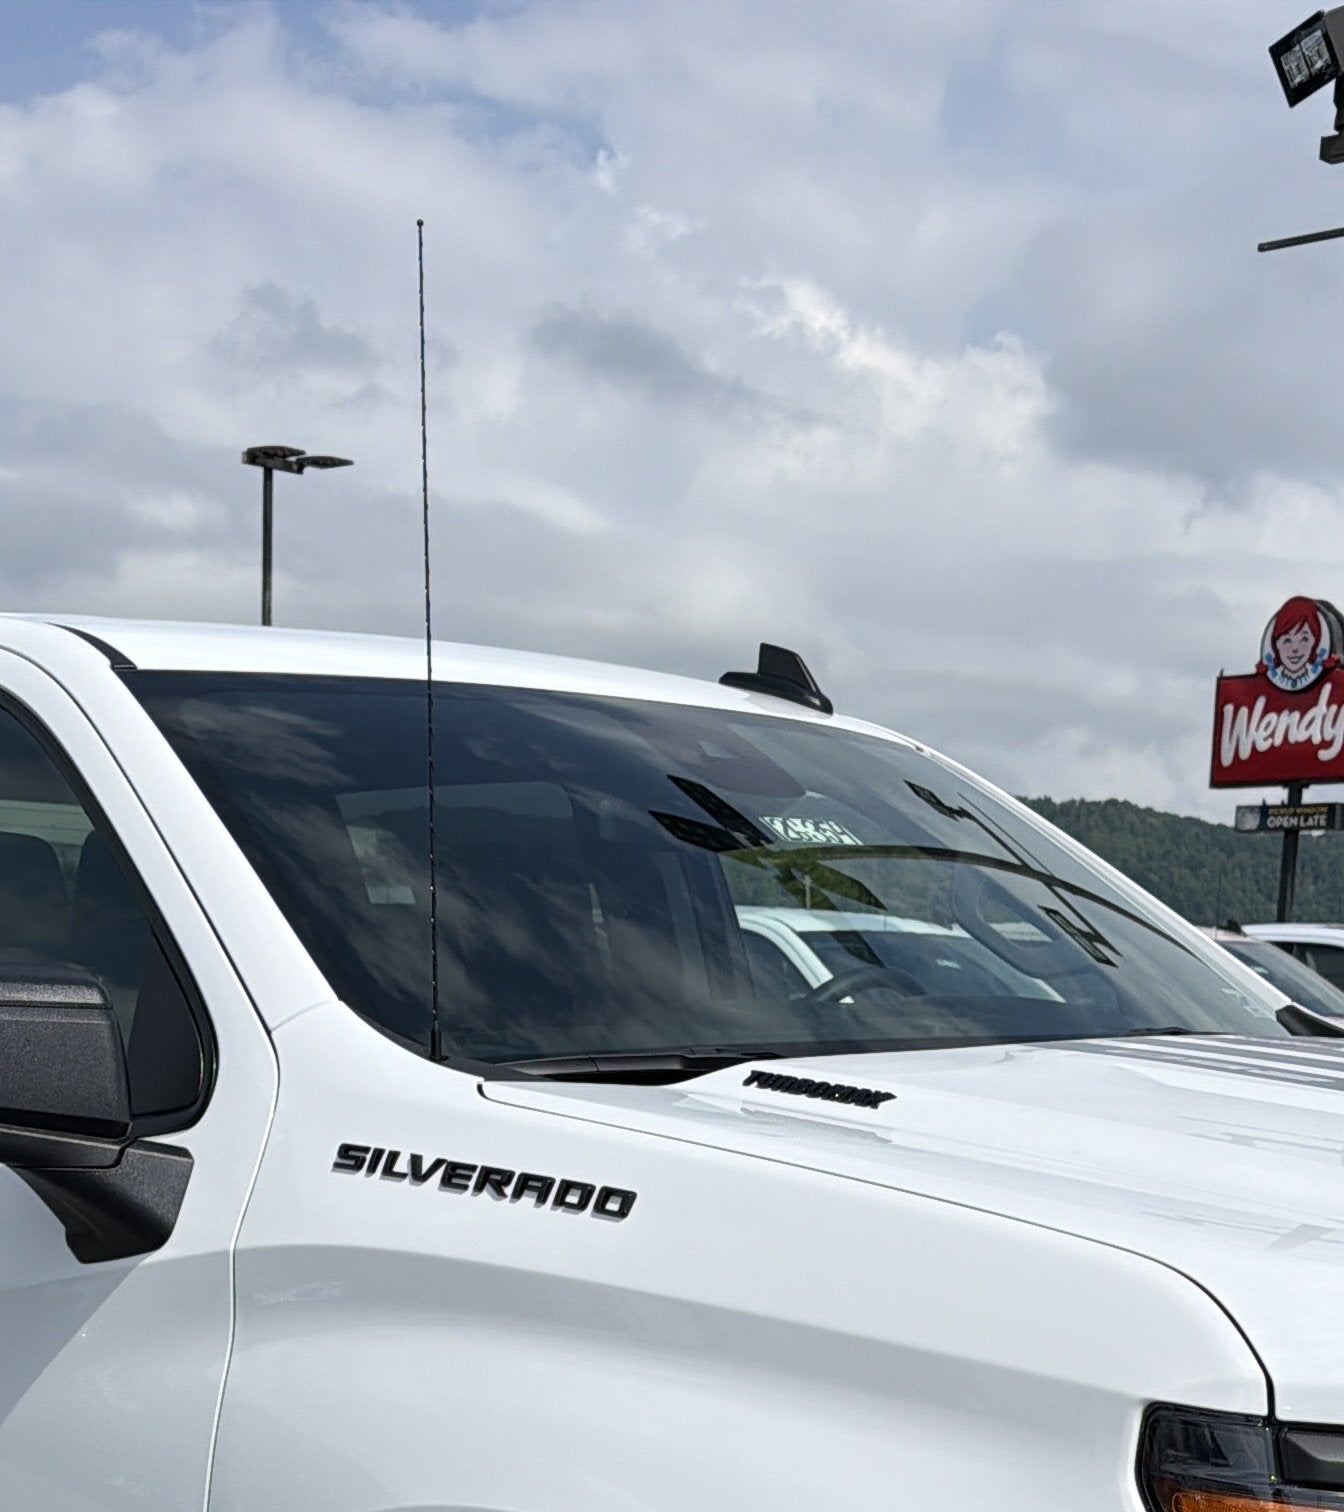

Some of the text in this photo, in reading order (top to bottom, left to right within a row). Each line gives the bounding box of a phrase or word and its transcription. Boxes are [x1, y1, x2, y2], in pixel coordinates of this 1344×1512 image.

[1266, 813, 1328, 829] OPEN LATE
[336, 1141, 638, 1220] SILVERADO
